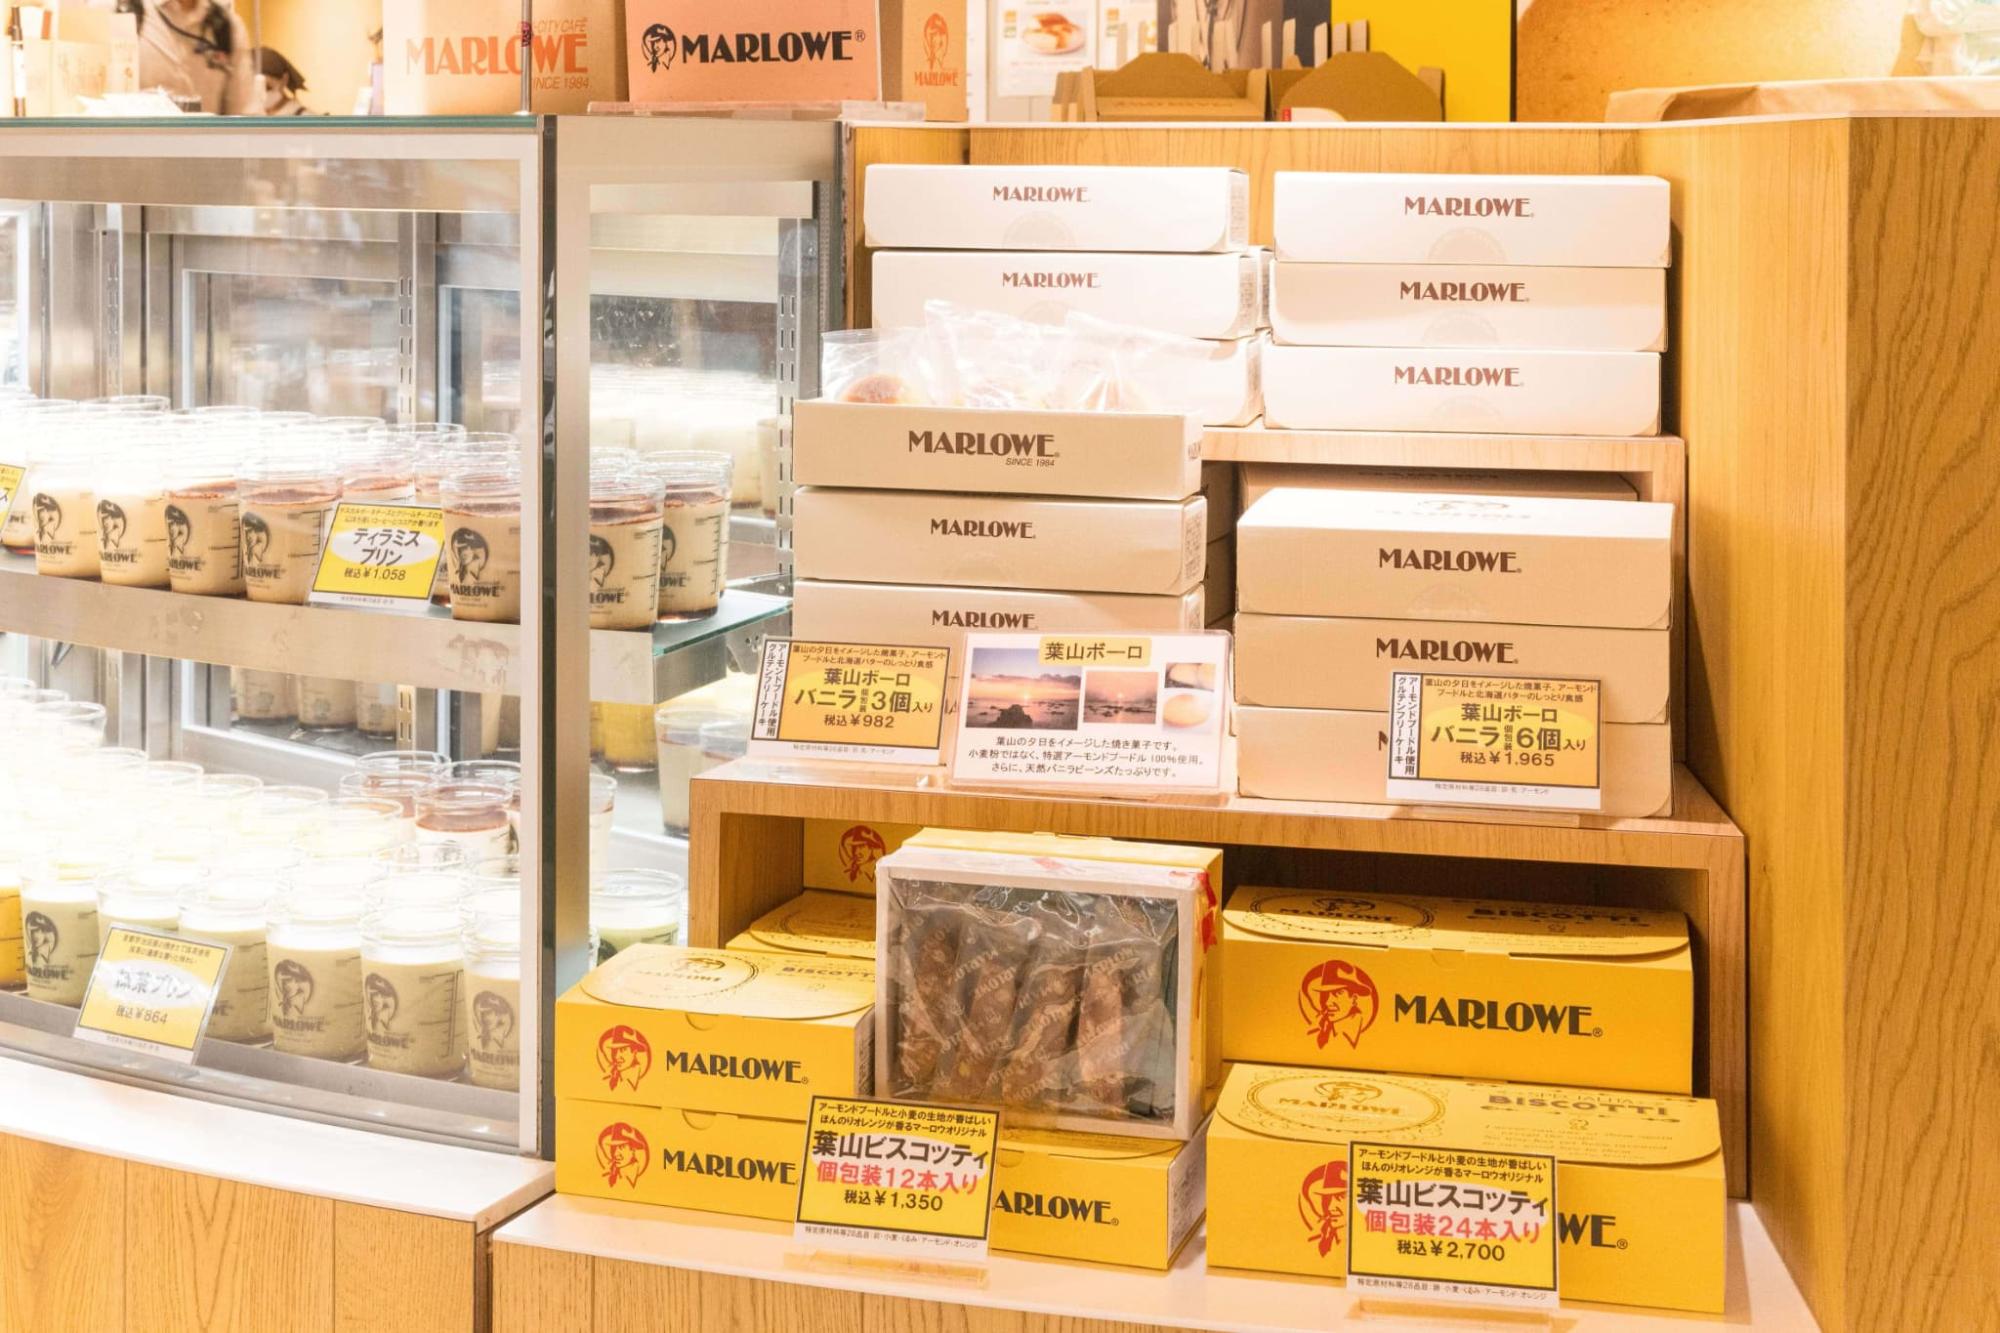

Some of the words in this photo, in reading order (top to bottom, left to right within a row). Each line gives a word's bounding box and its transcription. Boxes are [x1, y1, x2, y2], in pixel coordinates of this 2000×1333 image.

[914, 71, 959, 87] MARLOWE
[993, 186, 1089, 203] MARLOWE
[1404, 196, 1530, 217] MARLOWE
[1002, 272, 1099, 289] MARLOWE
[1400, 281, 1526, 303] MARLOWE
[1394, 366, 1520, 388] MARLOWE
[908, 430, 1056, 458] MARLOWE
[1005, 457, 1033, 467] SINCE
[1036, 458, 1055, 467] 1984
[353, 528, 421, 547] ティラミス
[931, 518, 1034, 539] MARLOWE
[360, 547, 403, 567] プリン
[1379, 548, 1517, 574] MARLOWE
[932, 610, 1035, 629] MARLOWE
[1044, 641, 1143, 660] 葉山ボーロ
[1376, 637, 1515, 664] MARLOWE
[824, 668, 911, 687] 葉山ボーロ
[824, 713, 895, 729] 税込¥982
[1461, 703, 1558, 723] 葉山ボーロ
[995, 736, 1177, 751] 葉山の夕日をイメージした焼き菓子です。
[991, 762, 1177, 778] さらに、天然バニラビーンズたっぷりです。
[783, 966, 876, 979] BISCOTT
[1488, 1094, 1669, 1116] BISCOTTI
[812, 1129, 989, 1170] 葉山ビスコッティ
[663, 1148, 798, 1185] MARLOWE
[816, 1160, 979, 1195] 個包装12本入り
[994, 1189, 1112, 1225] ARLOWE
[1356, 1177, 1549, 1217] 葉山ビスコッティ
[1364, 1209, 1541, 1244] 個包装24本入り
